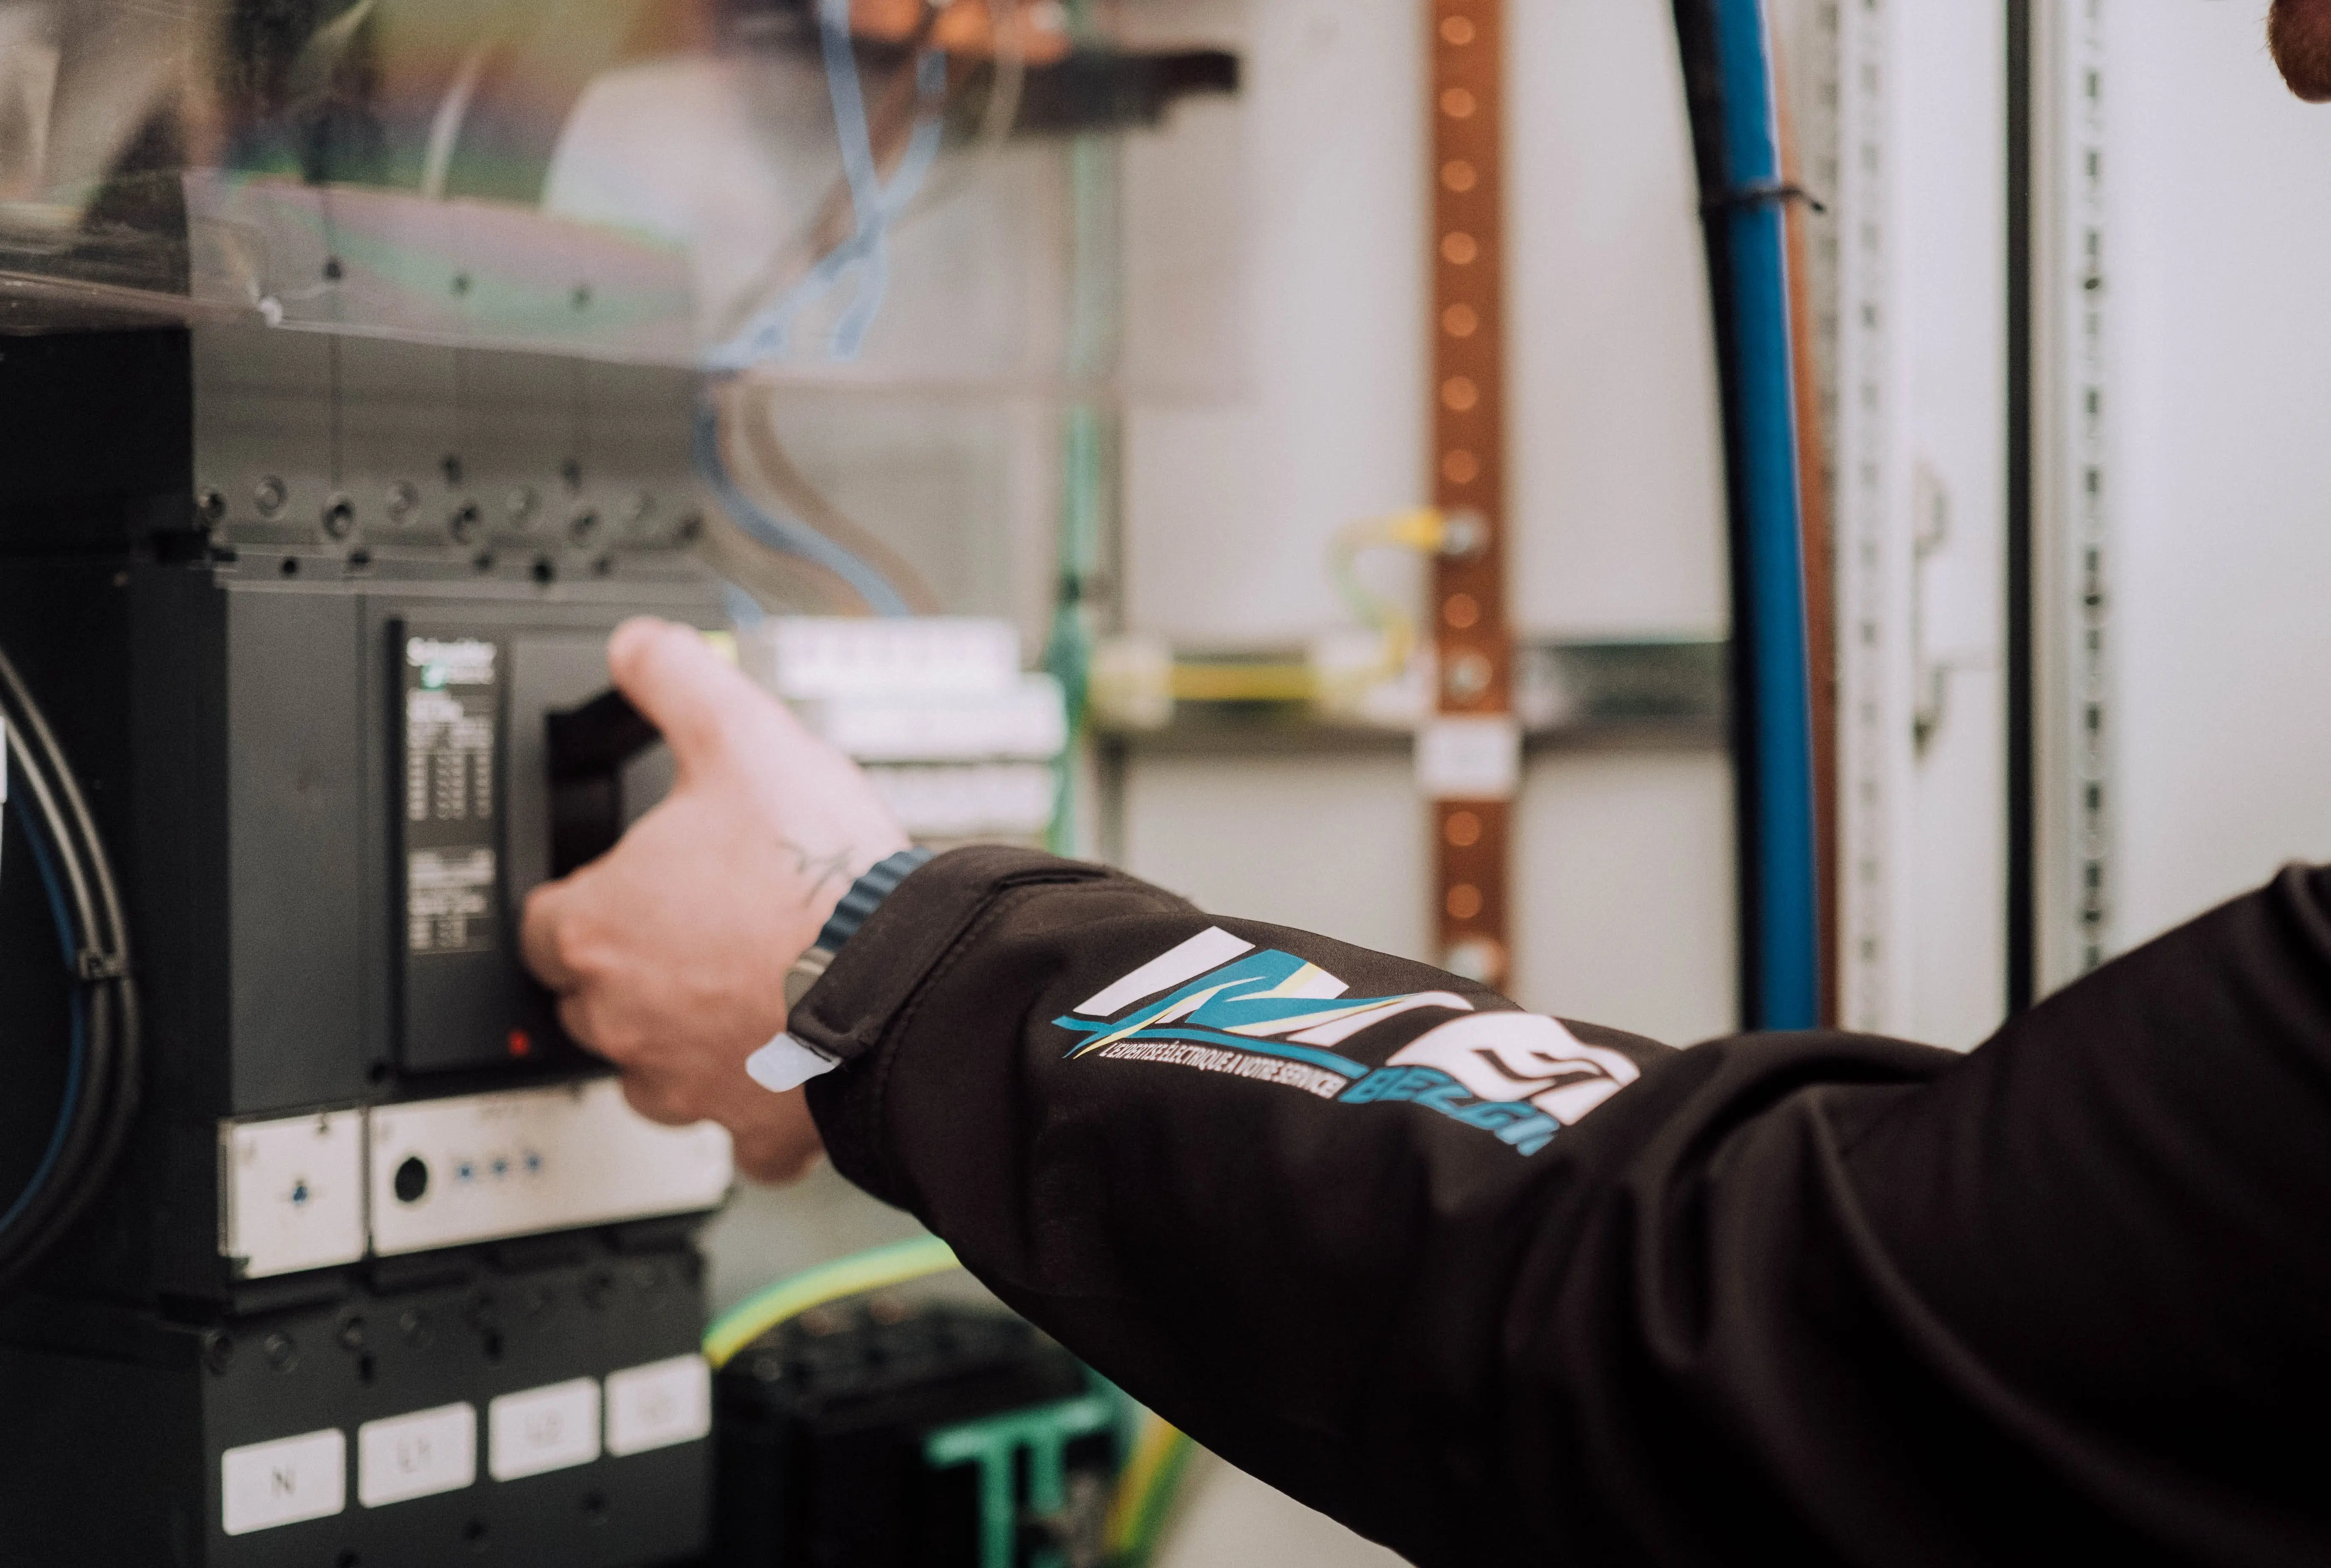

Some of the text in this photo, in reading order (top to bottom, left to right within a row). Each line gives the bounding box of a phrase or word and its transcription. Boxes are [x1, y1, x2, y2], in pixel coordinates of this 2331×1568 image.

[1099, 1042, 1166, 1061] L'EXPERTISE
[1156, 1041, 1234, 1071] ÉLECTRIQUE
[1234, 1057, 1284, 1081] VOTRE
[271, 1464, 296, 1499] N
